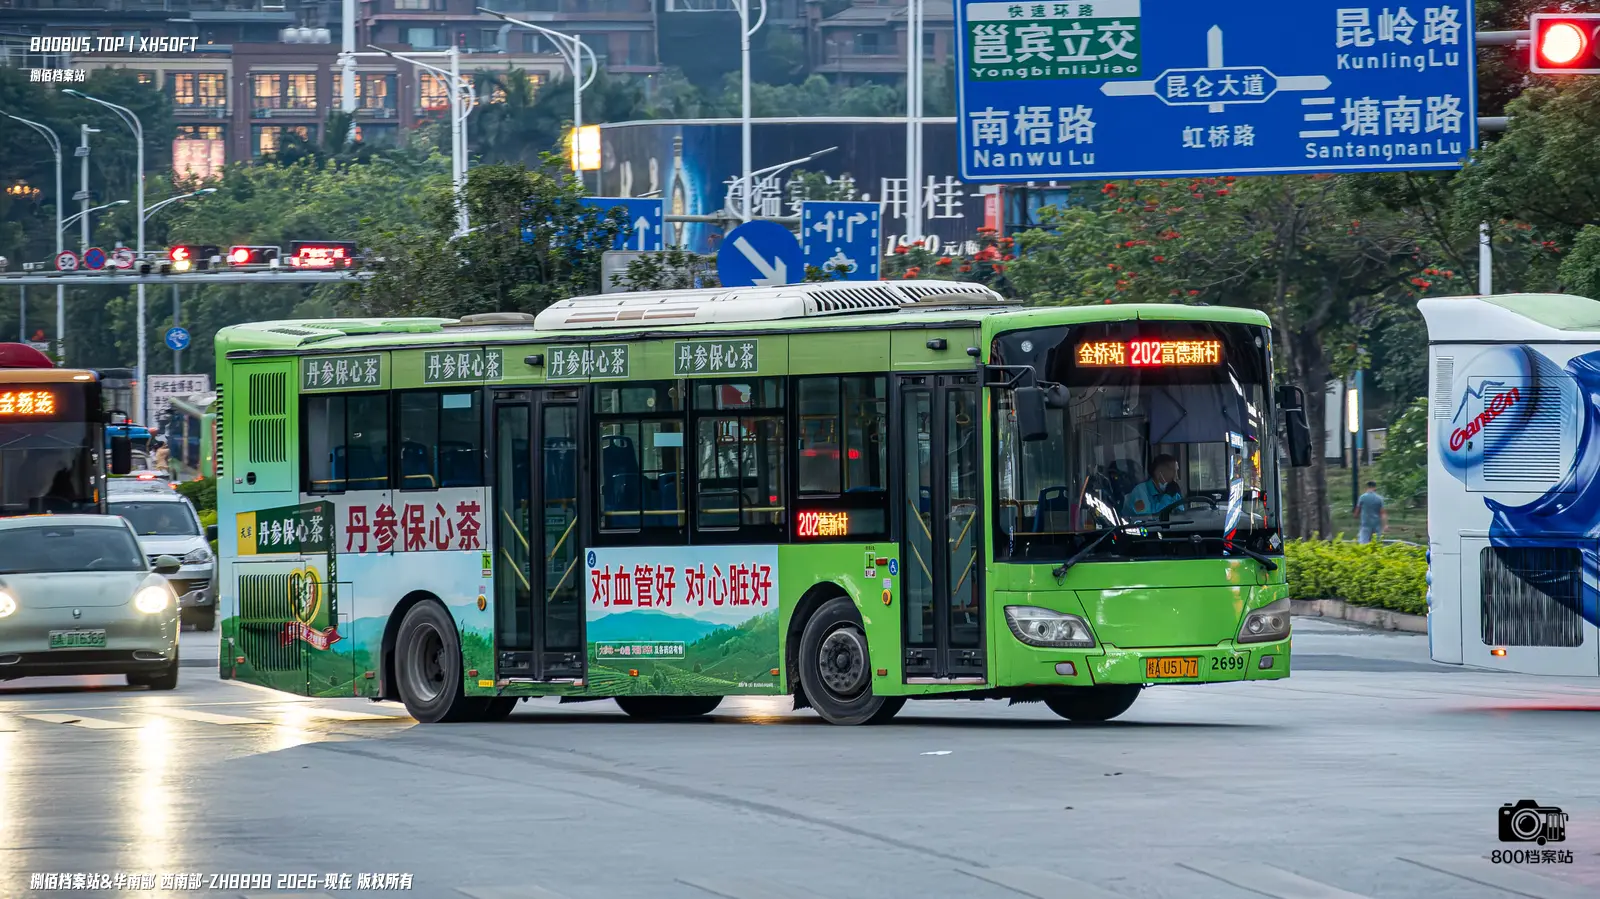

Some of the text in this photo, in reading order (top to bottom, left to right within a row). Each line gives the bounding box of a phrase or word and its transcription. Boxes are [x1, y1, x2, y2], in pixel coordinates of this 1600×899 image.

[1008, 3, 1094, 18] 快速环路
[1335, 5, 1462, 48] 昆岭路
[972, 21, 1137, 64] 邕宾立交
[1166, 74, 1265, 98] 昆仑大道
[969, 105, 1096, 147] 南梧路
[1299, 94, 1464, 138] 三塘南路
[1182, 124, 1256, 149] 虹桥路
[973, 149, 1095, 168] Nanwu Lu
[427, 352, 500, 380] 丹参保心茶
[551, 348, 625, 376] 丹参保心茶
[677, 343, 754, 371] 丹参保心茶
[1078, 342, 1125, 364] 金桥站
[306, 358, 378, 386] 丹参保心茶
[258, 515, 324, 546] 丹参保心茶
[345, 501, 482, 554] 丹参保心茶
[591, 562, 773, 608] 对血管好 对心脏好
[1211, 656, 1244, 671] 2699
